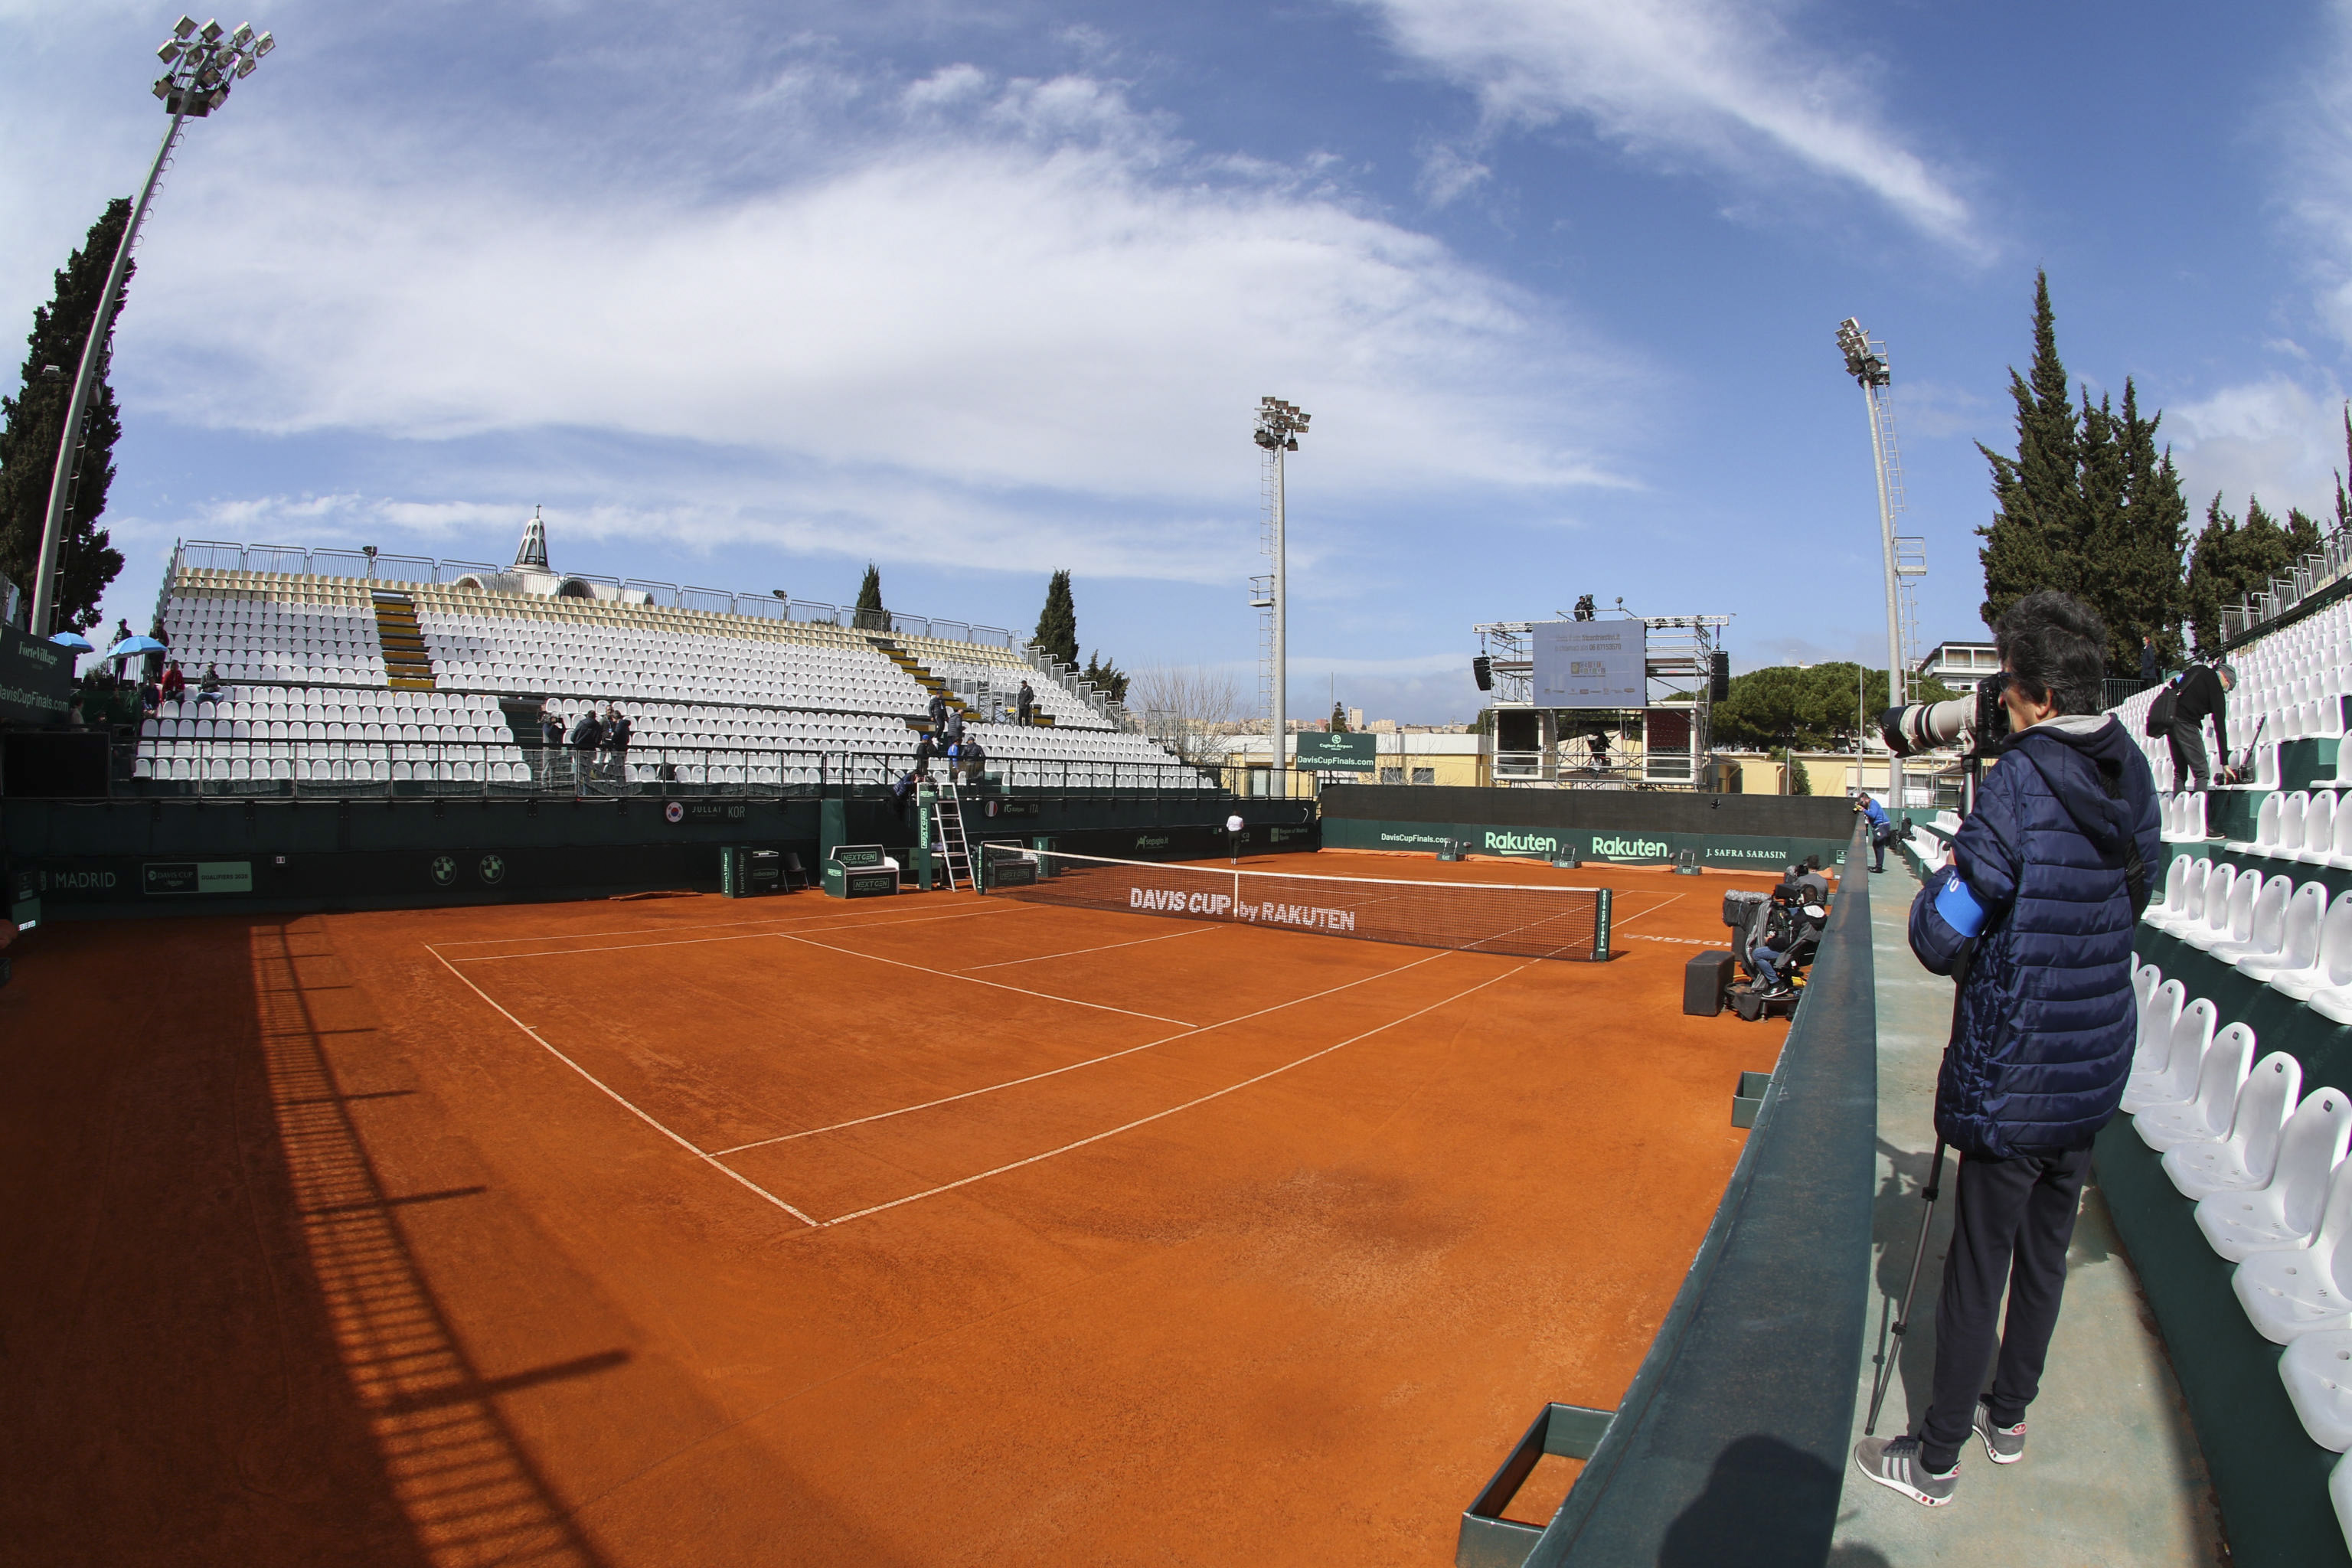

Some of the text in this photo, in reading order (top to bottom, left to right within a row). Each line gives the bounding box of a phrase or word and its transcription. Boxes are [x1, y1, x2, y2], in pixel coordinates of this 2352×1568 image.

[18, 641, 57, 668] ForteVillage
[1298, 756, 1374, 766] DavisCupFinals.com
[728, 805, 746, 818] KOR
[1485, 831, 1557, 852] Rakuten
[1592, 837, 1668, 858] Rakuten
[1714, 849, 1743, 858] SAFRA
[1746, 851, 1786, 859] SARASIN
[56, 872, 116, 888] MADRID
[1130, 887, 1354, 931] DAVIS CUP by RAKUTEN
